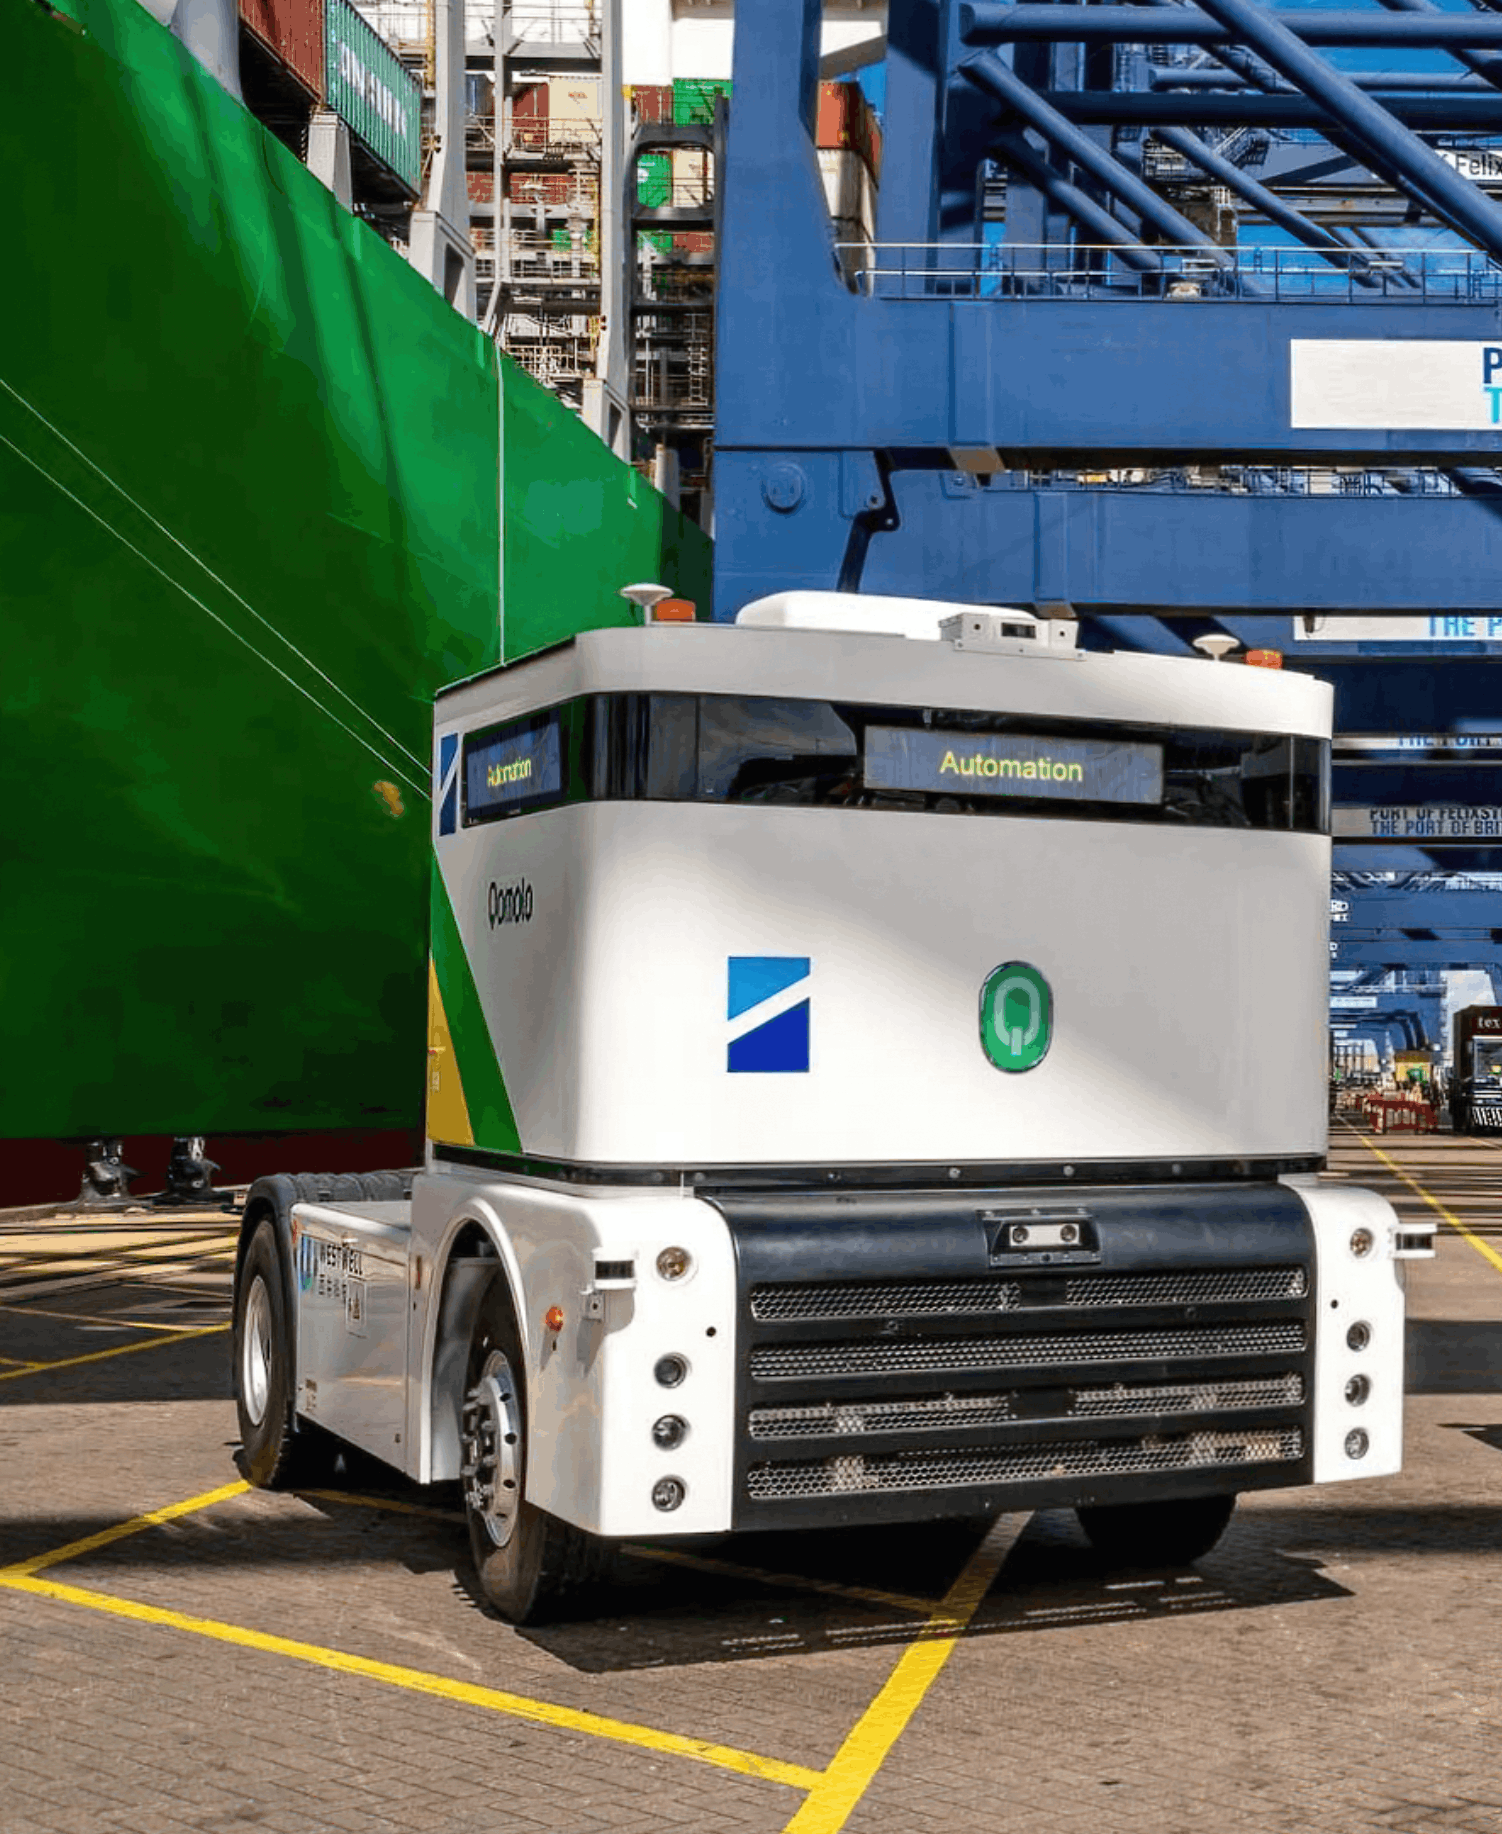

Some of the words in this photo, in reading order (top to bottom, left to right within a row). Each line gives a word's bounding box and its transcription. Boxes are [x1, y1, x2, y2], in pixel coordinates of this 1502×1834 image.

[1427, 615, 1475, 637] THE
[940, 751, 1083, 783] Automation
[1370, 808, 1408, 820] PORT
[1371, 820, 1399, 835] THE
[1406, 820, 1444, 835] PORT
[1451, 820, 1469, 835] OF
[488, 877, 533, 931] Qomolo
